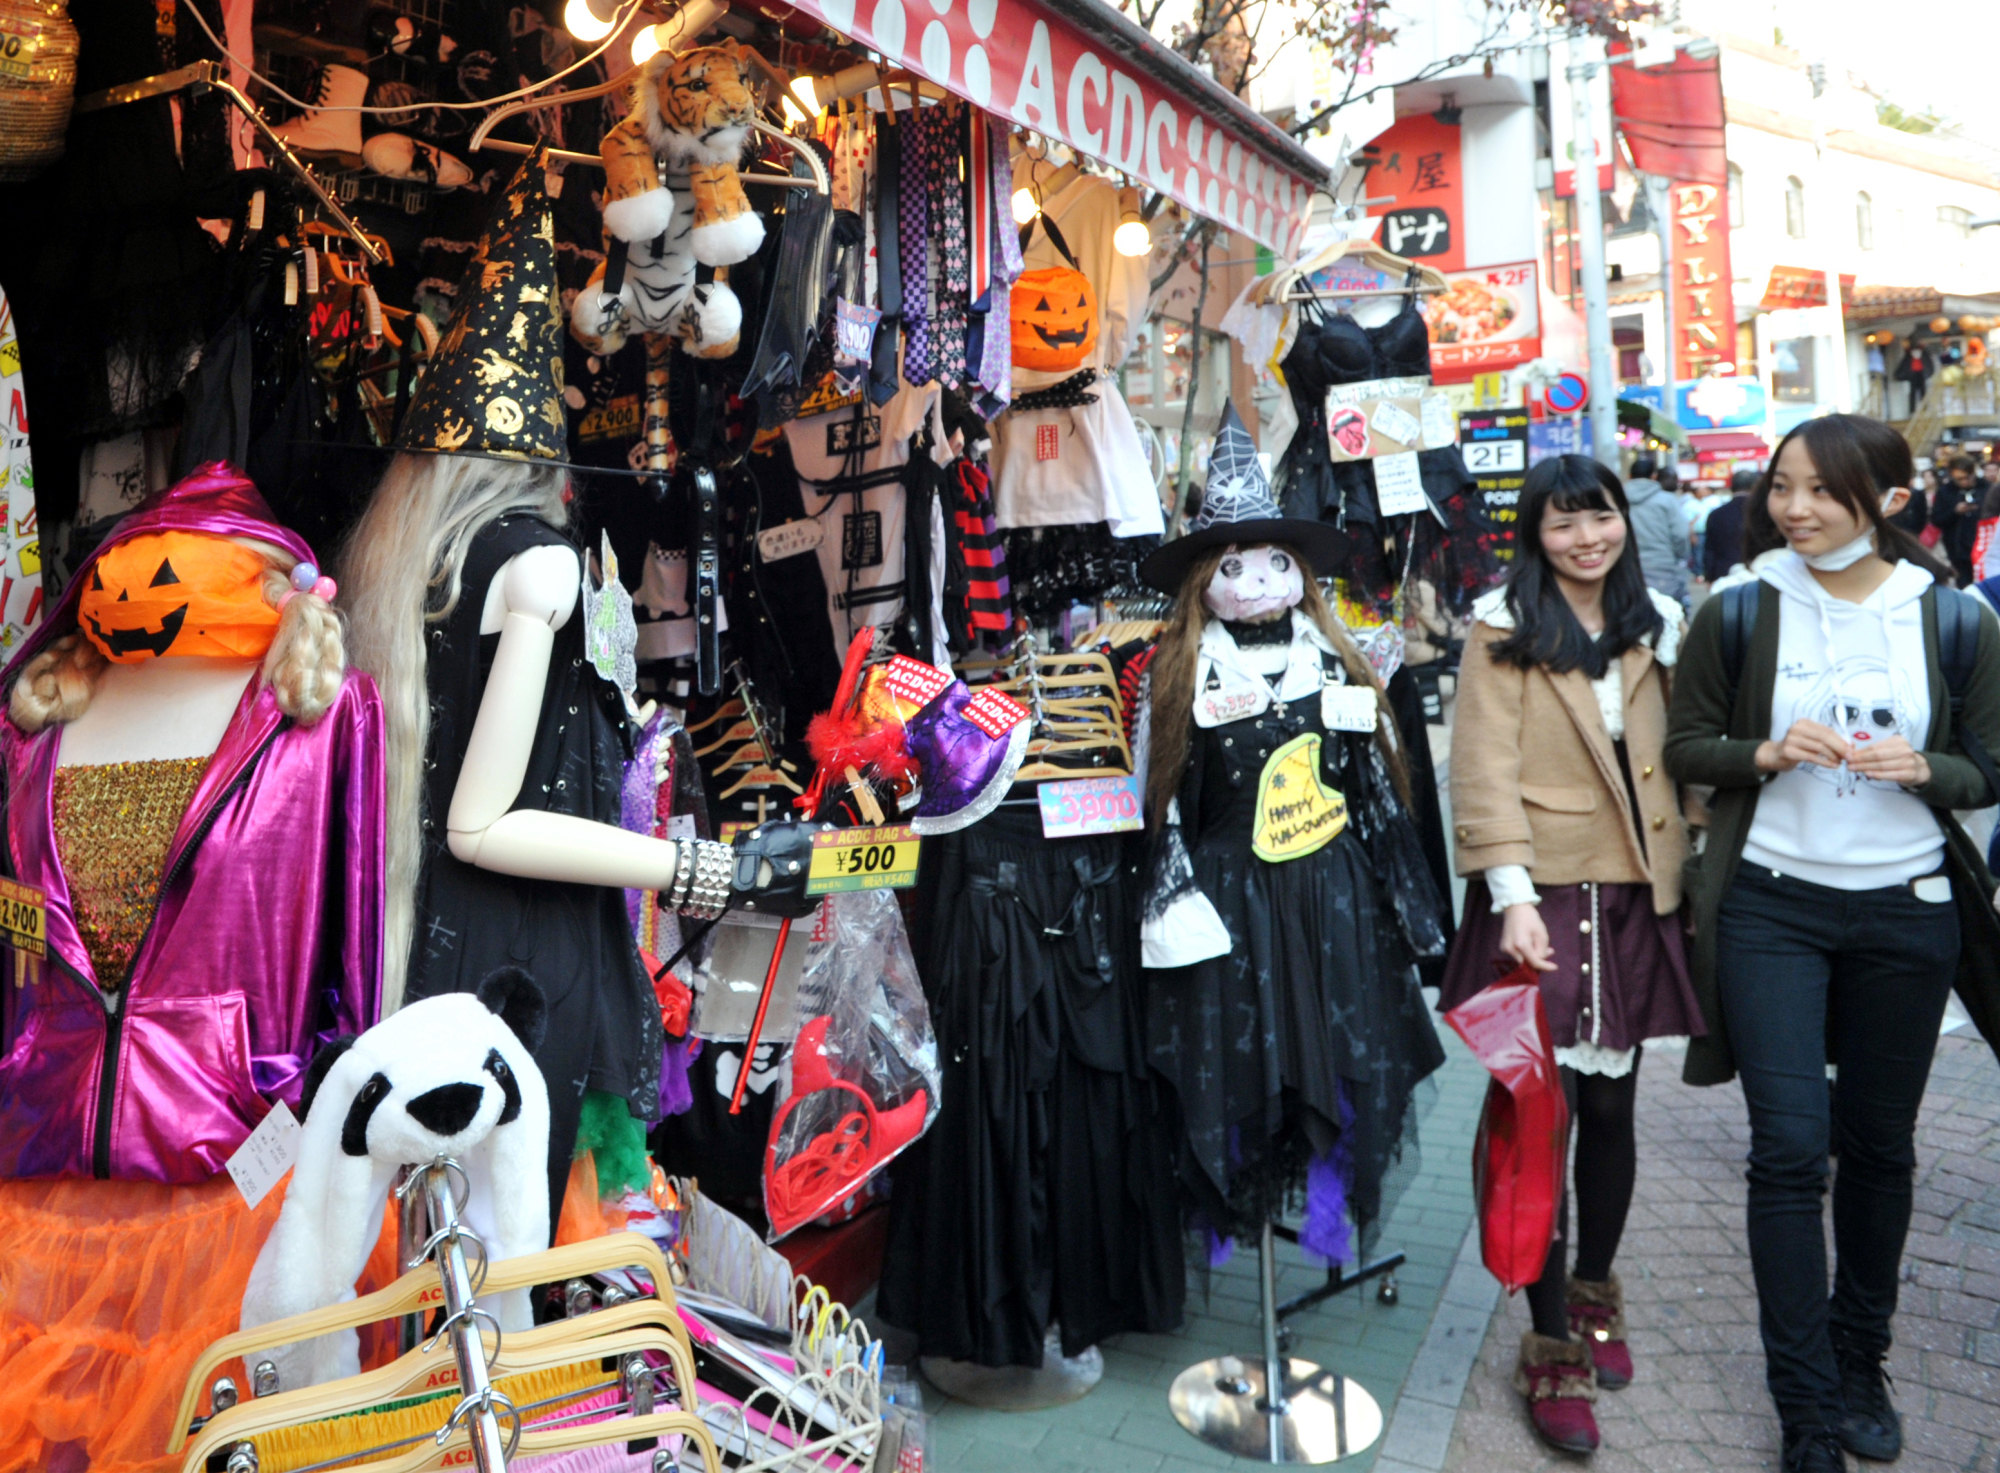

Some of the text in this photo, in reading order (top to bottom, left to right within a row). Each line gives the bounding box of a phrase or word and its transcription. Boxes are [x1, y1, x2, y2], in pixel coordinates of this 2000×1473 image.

[1011, 19, 1178, 195] ACDC
[1388, 213, 1448, 253] ドナ
[1505, 268, 1531, 286] 2F
[1432, 343, 1521, 365] ミートソース
[1472, 445, 1515, 467] 2F
[888, 668, 935, 693] ACDC
[972, 696, 1012, 725] ACDC
[1268, 796, 1314, 825] HAPPY
[1268, 802, 1345, 848] HALLOWEEN
[837, 827, 899, 845] ACDC RAG
[836, 844, 896, 874] ¥500
